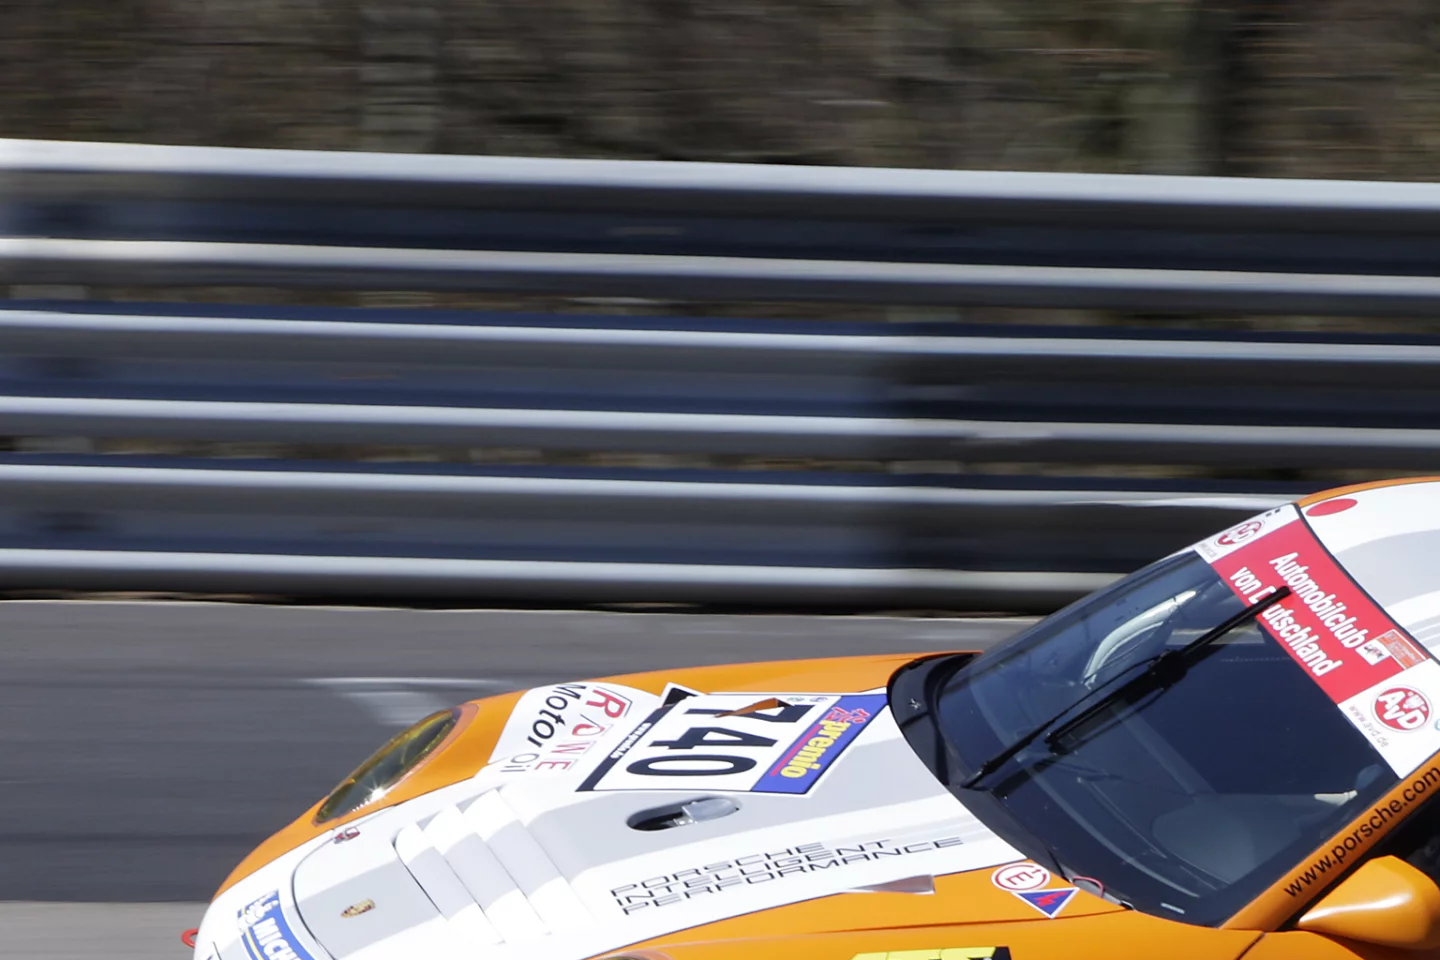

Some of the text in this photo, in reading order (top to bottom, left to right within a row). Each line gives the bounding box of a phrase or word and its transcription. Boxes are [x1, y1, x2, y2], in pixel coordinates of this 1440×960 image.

[1230, 566, 1261, 594] von
[1248, 584, 1343, 677] Dutschland
[1269, 552, 1369, 649] Automobilclub
[527, 685, 587, 748] Motor
[780, 718, 852, 779] premio
[610, 842, 825, 898] PORSCHE
[616, 839, 891, 907] INTELLIGENT
[622, 836, 965, 917] PERFORMANCE
